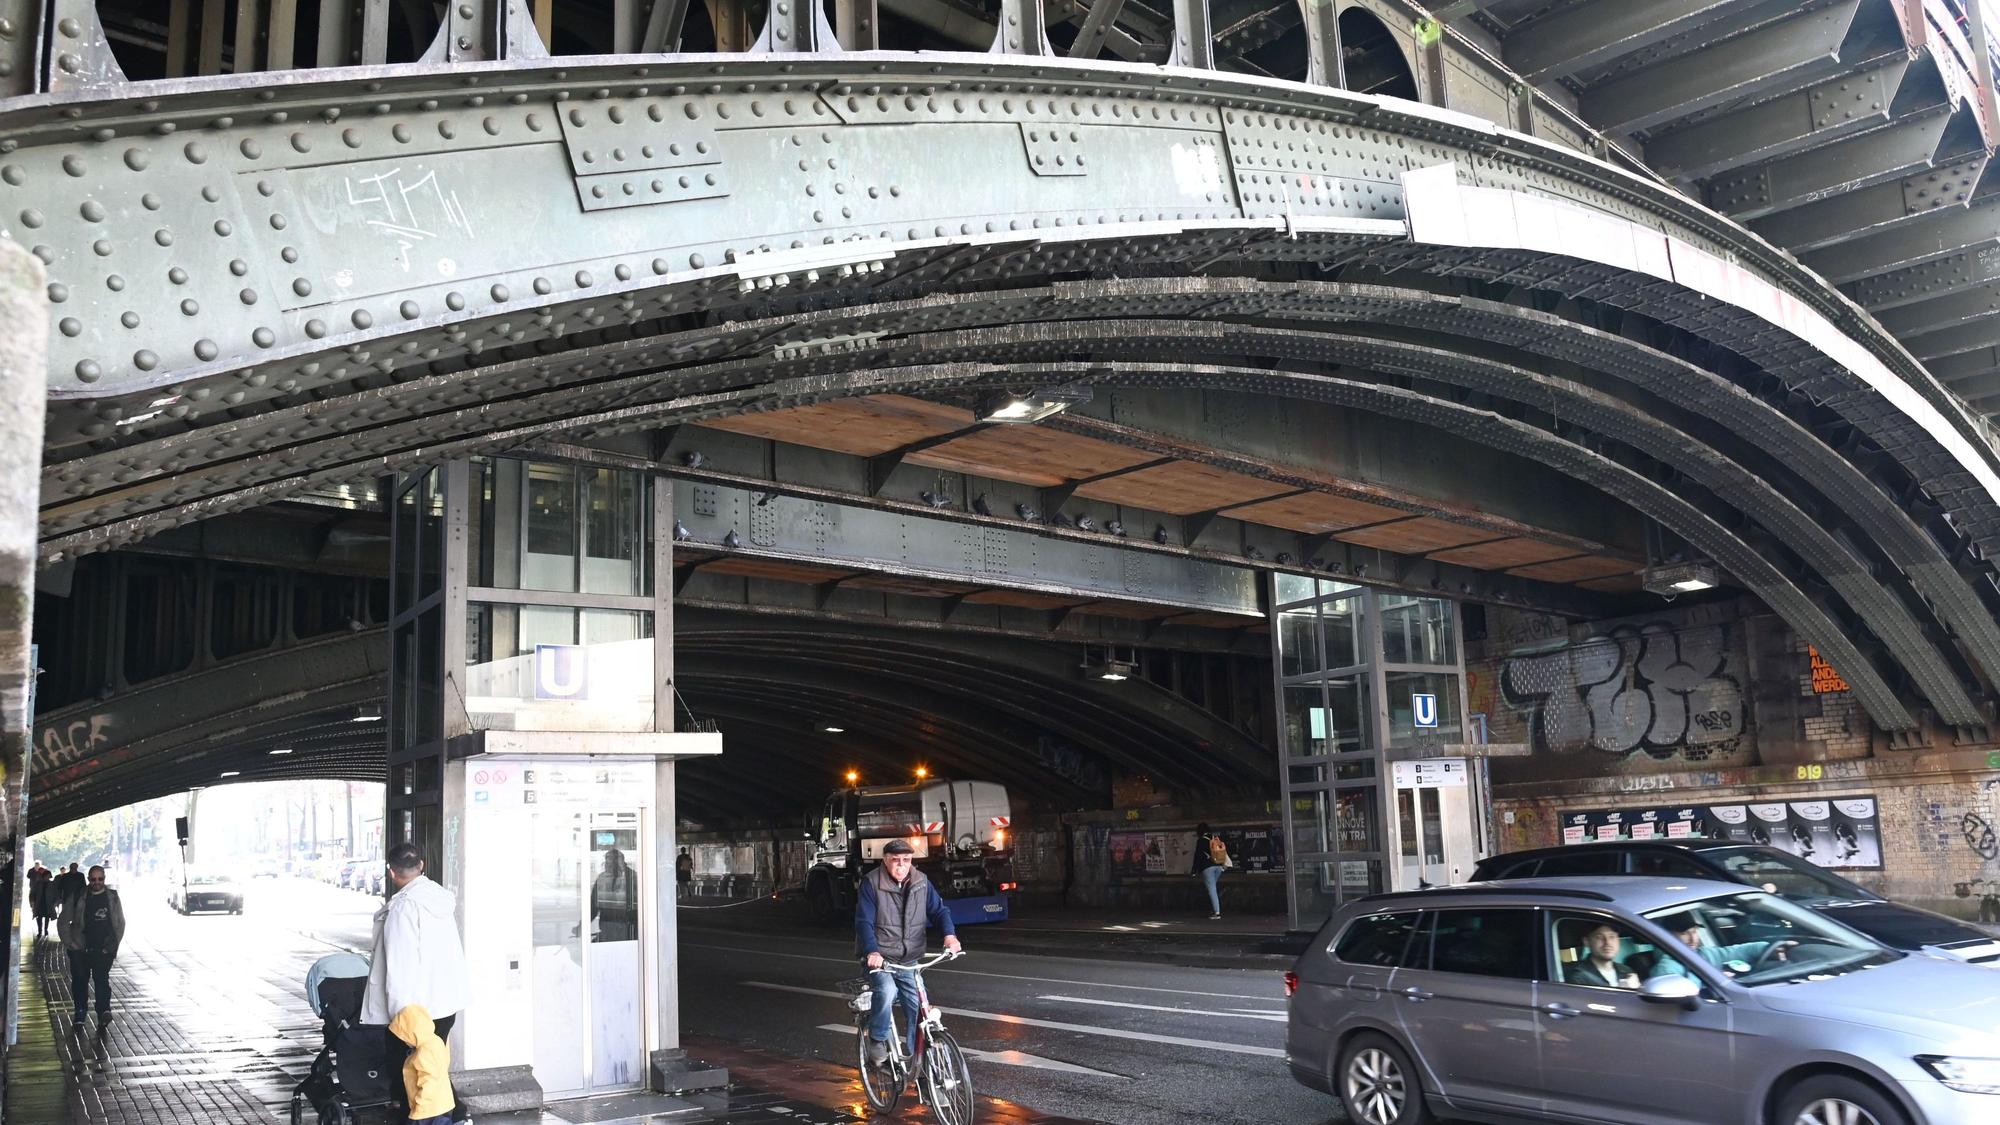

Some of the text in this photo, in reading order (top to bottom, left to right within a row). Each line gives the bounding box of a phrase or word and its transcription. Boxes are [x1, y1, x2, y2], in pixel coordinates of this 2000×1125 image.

[540, 648, 585, 697] U
[1813, 667, 1840, 680] ANDE
[1813, 679, 1850, 693] WERDE
[1415, 696, 1435, 725] U
[1797, 764, 1822, 780] 819
[1349, 830, 1367, 841] TRA
